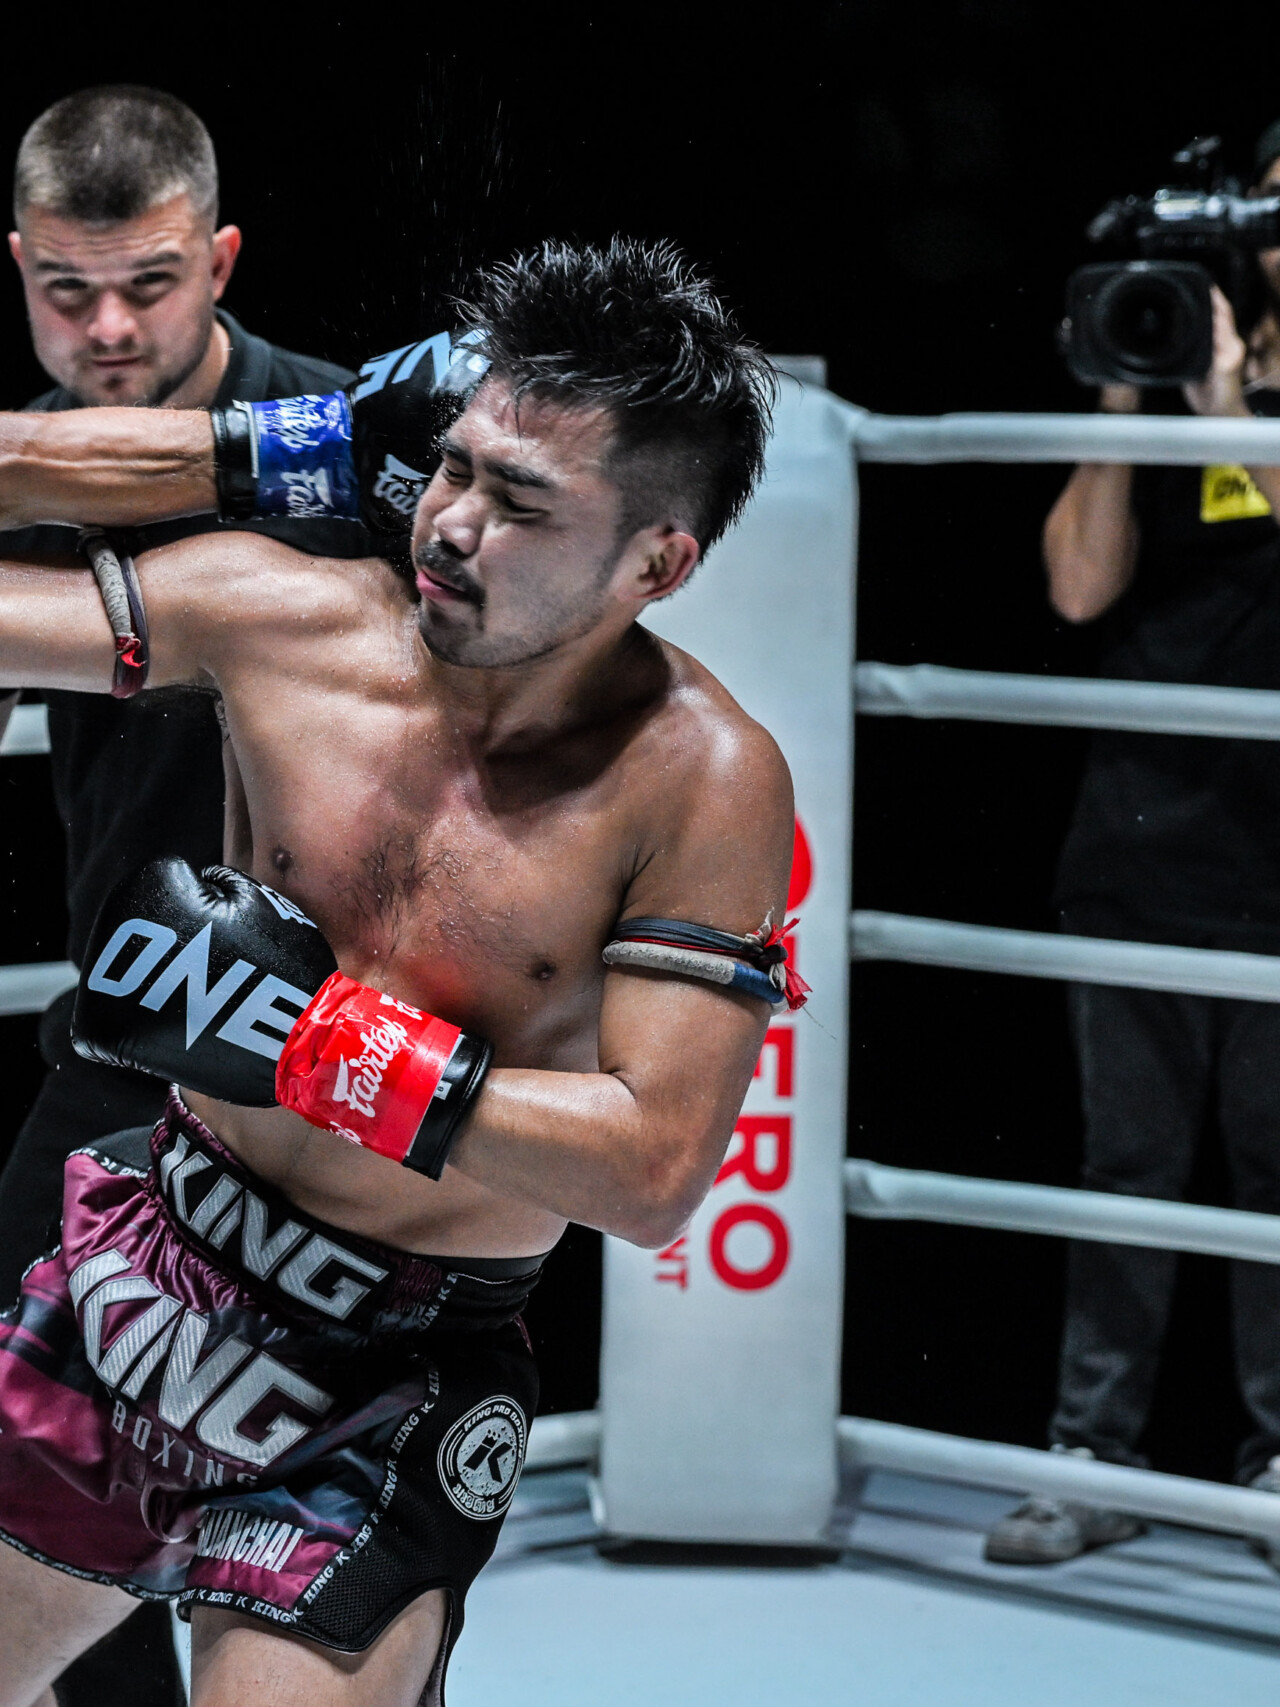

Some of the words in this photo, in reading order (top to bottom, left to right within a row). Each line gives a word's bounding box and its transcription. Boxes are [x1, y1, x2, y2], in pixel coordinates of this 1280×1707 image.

[87, 917, 318, 1061] ONE
[332, 1015, 408, 1118] Fairtex
[160, 1132, 390, 1321] KING
[69, 1248, 334, 1467] KING
[464, 1406, 492, 1432] KING
[492, 1405, 511, 1416] PRO
[111, 1400, 258, 1486] BOXING
[303, 1565, 335, 1605] KING
[379, 1471, 398, 1509] KING
[391, 1412, 420, 1454] KING
[251, 1601, 293, 1624] KING
